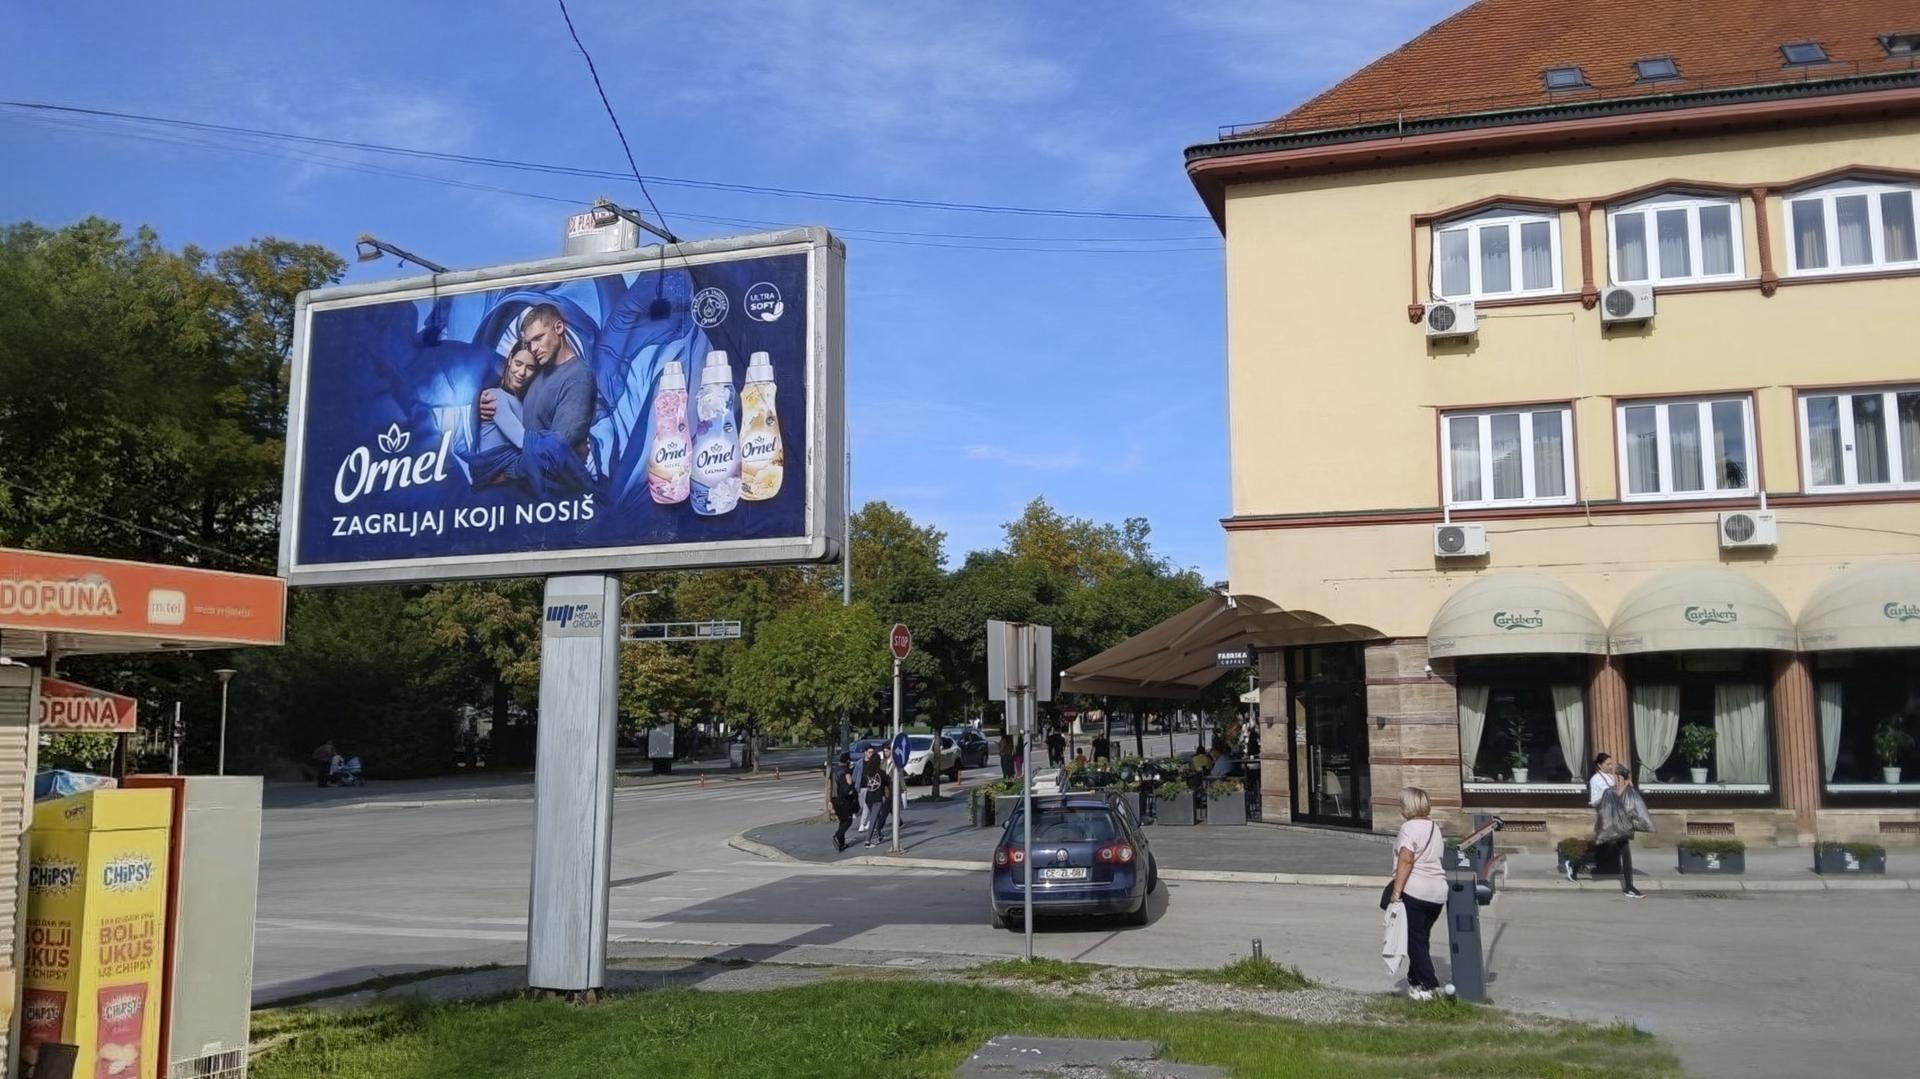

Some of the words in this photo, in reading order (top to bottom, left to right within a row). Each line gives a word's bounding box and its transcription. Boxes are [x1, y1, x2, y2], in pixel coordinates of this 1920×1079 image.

[750, 292, 775, 301] ULTRA
[750, 301, 775, 311] SOFT
[655, 443, 688, 464] Ornel
[696, 444, 735, 469] Ornel
[741, 437, 776, 459] Ornel
[334, 430, 452, 504] Ornel
[331, 510, 445, 537] ZAGRLJAJ
[454, 505, 506, 532] KOJI
[515, 493, 594, 525] NOSIŠ
[0, 584, 113, 611] DOPUNA
[1493, 611, 1543, 630] Carlsberg
[1684, 604, 1737, 625] Carlsberg
[1883, 602, 1920, 622] Carlsb
[894, 635, 908, 647] STOP
[26, 927, 71, 947] OLJI
[100, 920, 154, 945] BOLJI
[99, 938, 153, 966] UKUS
